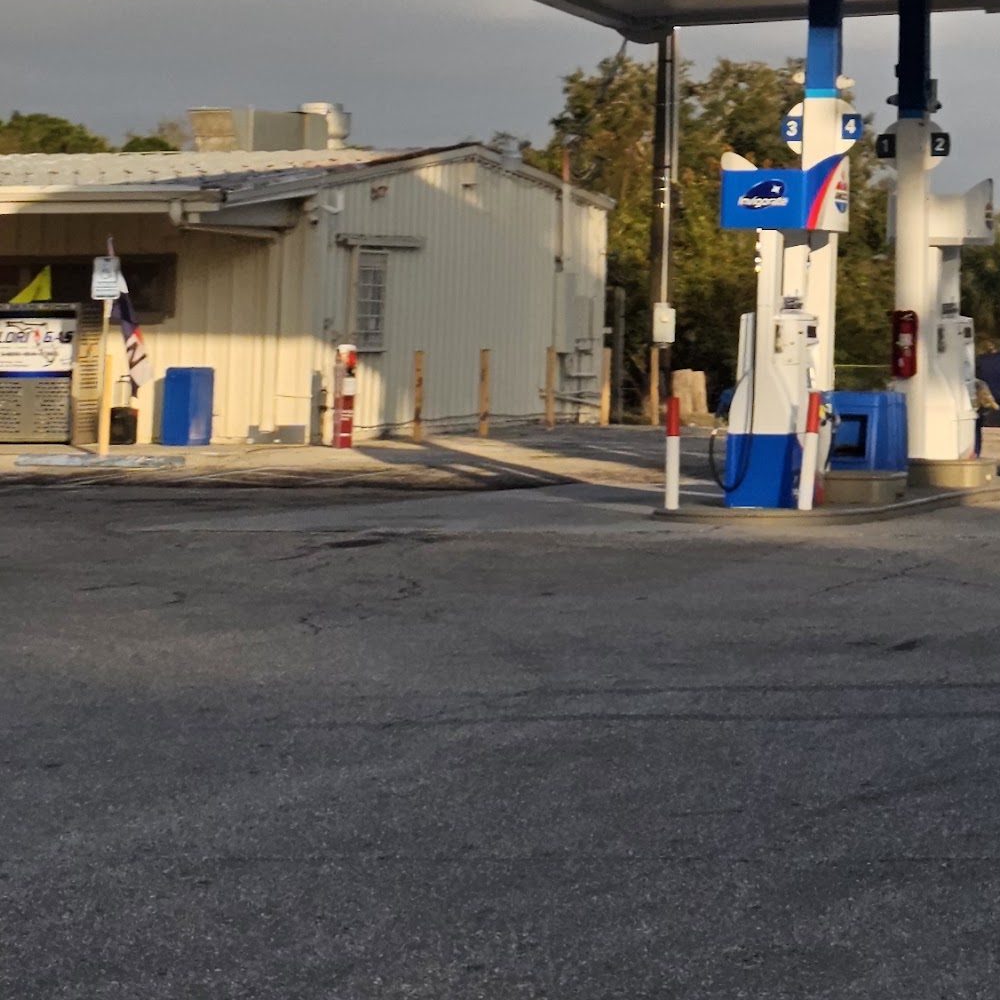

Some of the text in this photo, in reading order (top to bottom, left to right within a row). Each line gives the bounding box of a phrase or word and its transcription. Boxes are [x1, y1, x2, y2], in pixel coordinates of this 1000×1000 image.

[785, 120, 798, 137] 3
[844, 118, 857, 134] 4
[882, 139, 889, 153] 1
[934, 137, 945, 152] 2
